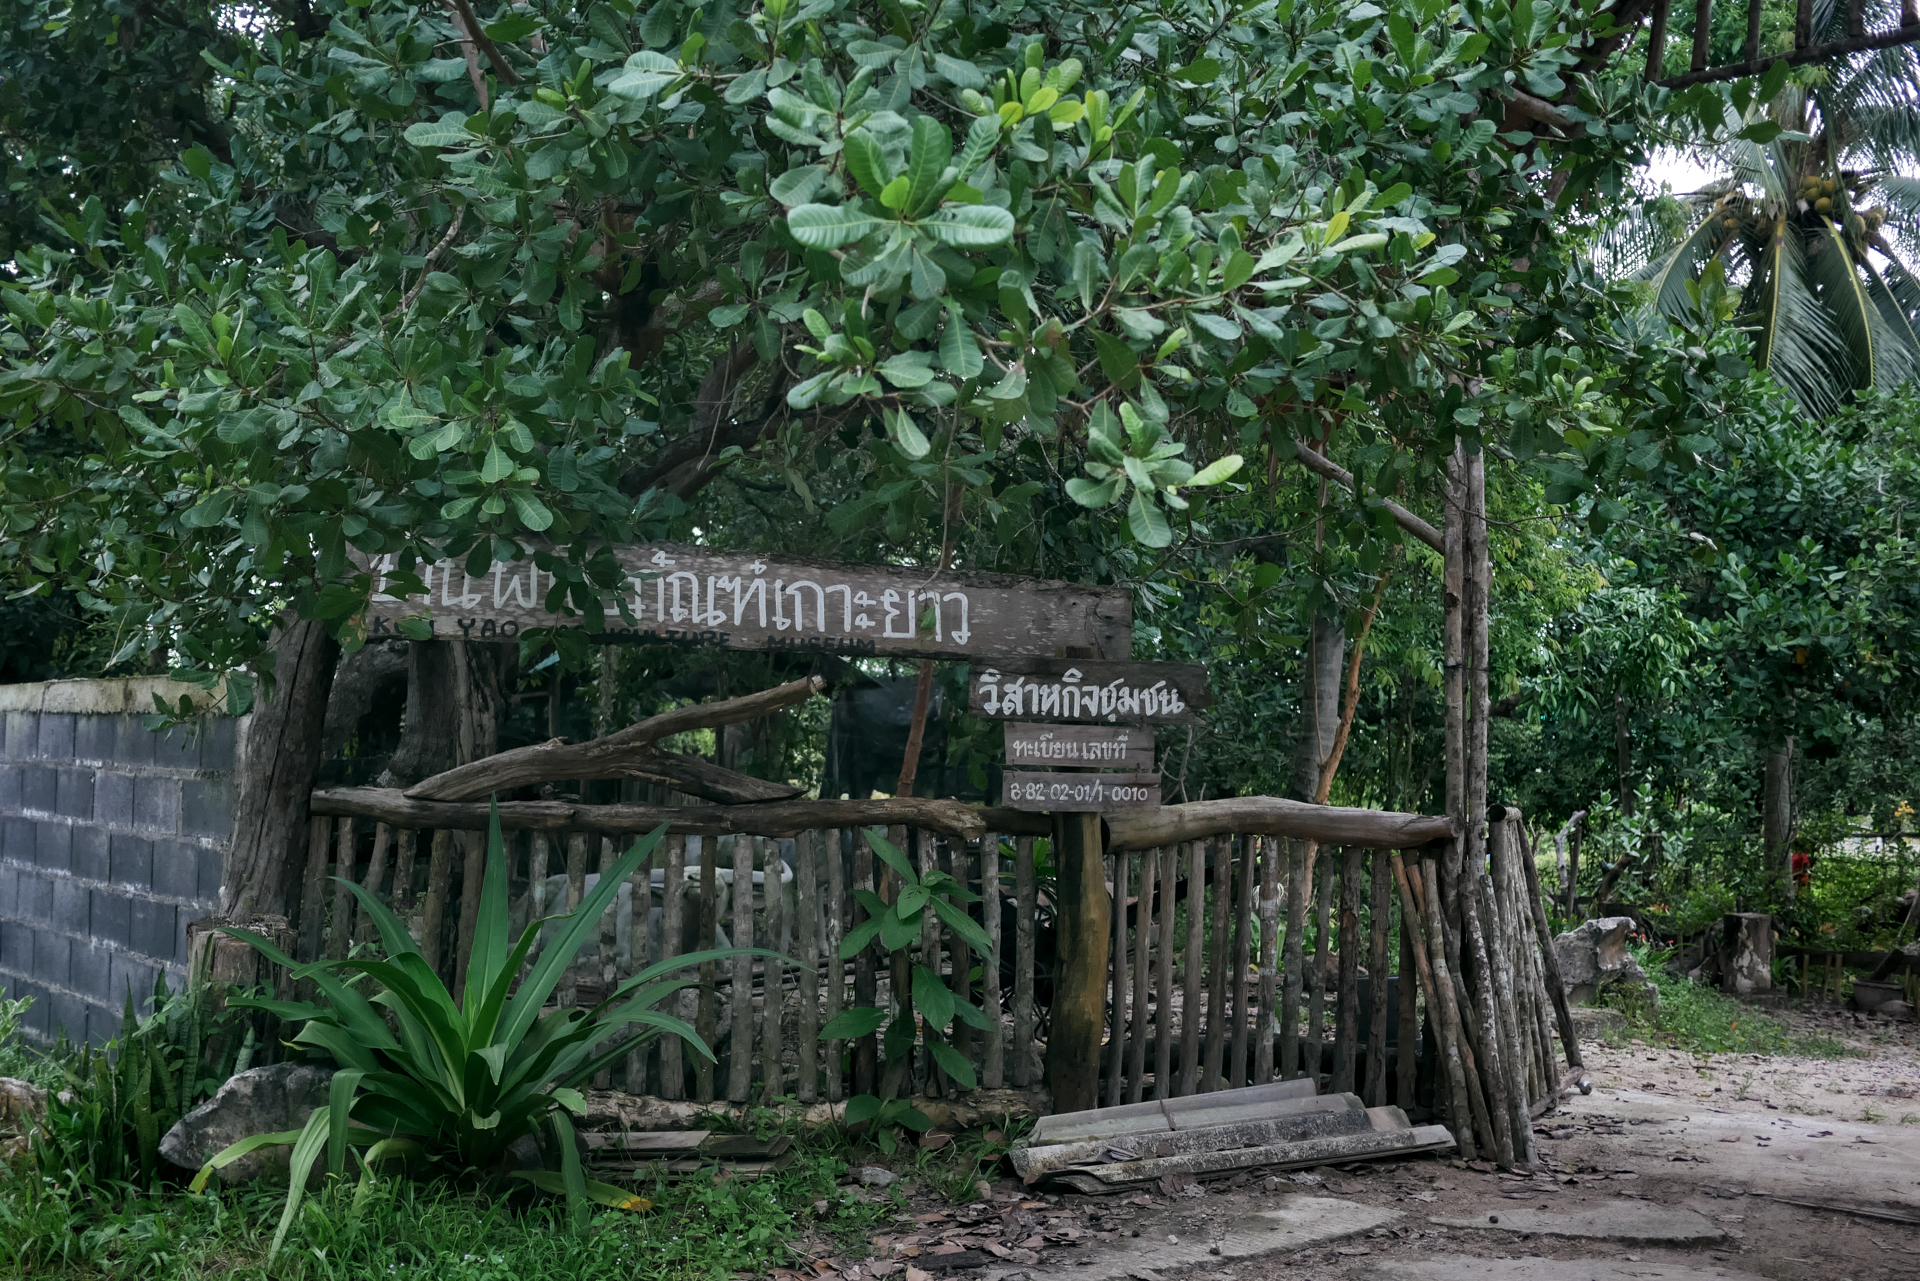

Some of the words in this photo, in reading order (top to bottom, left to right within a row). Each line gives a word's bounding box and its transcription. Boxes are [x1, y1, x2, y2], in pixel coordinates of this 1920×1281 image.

[457, 618, 520, 638] YAO
[767, 635, 876, 657] MUSEUM
[979, 667, 1185, 722] วิสาหกิจชุมชน
